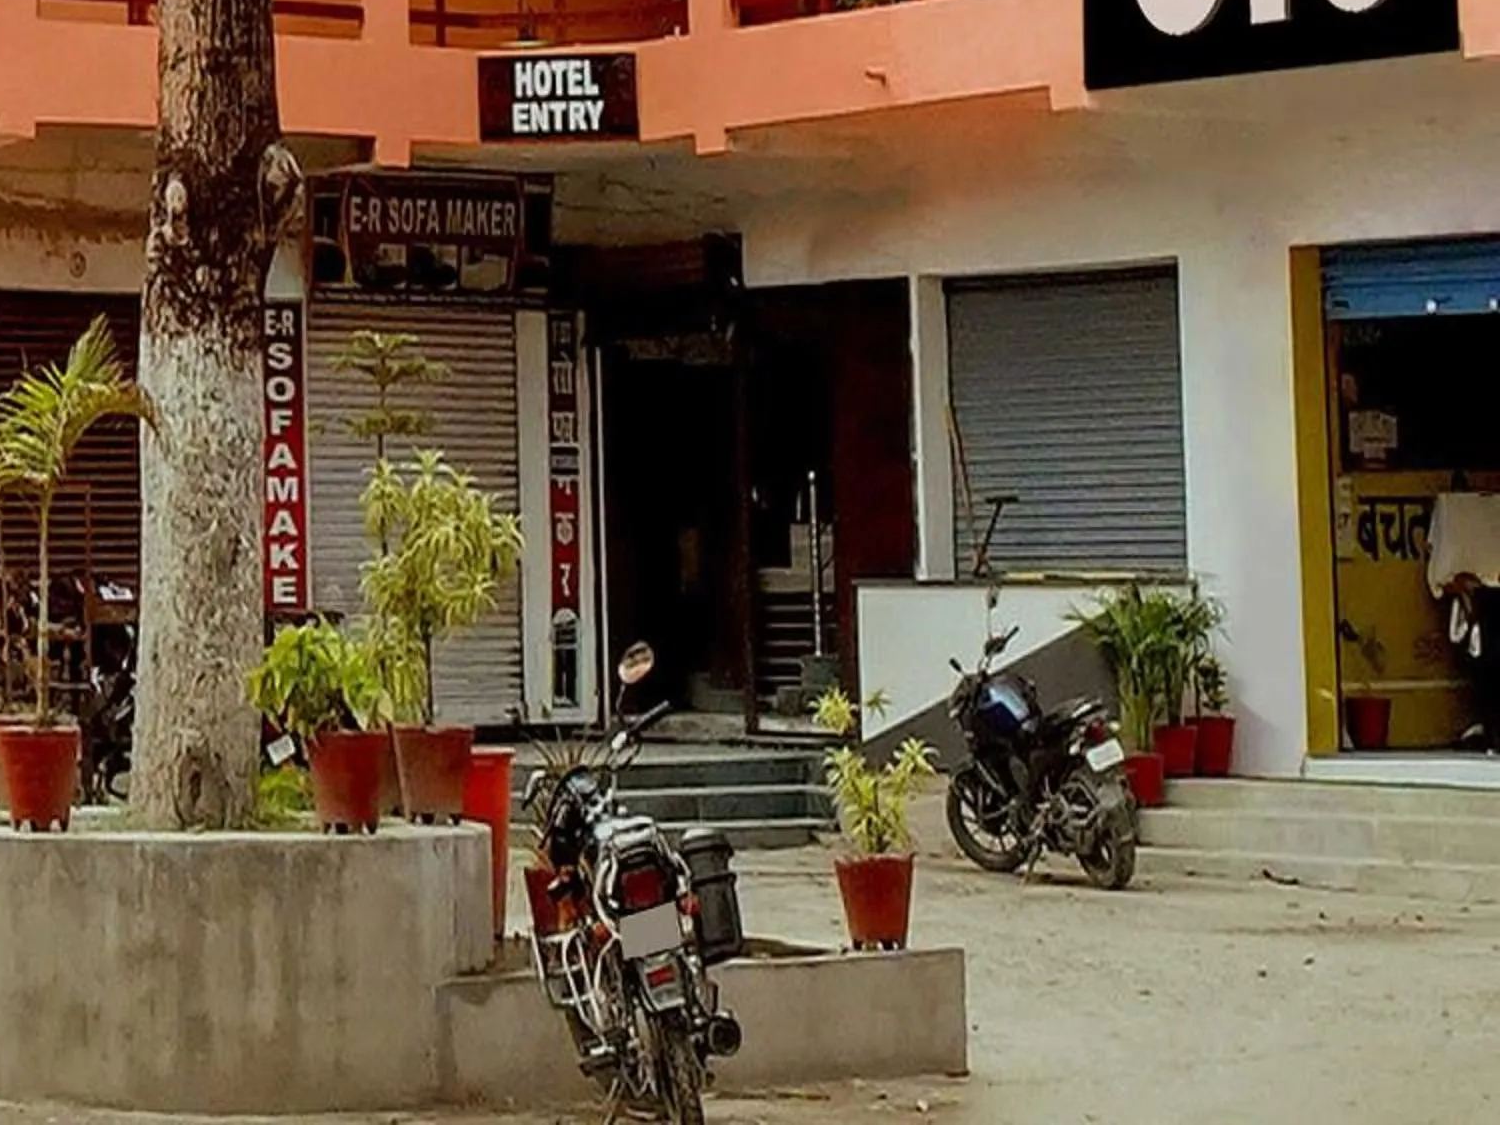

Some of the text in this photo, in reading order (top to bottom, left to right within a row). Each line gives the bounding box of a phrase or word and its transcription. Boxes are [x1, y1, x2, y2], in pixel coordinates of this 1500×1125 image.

[514, 59, 600, 98] HOTEL
[512, 100, 604, 133] ENTRY
[387, 197, 441, 235] SOFA
[446, 199, 516, 237] MAKER
